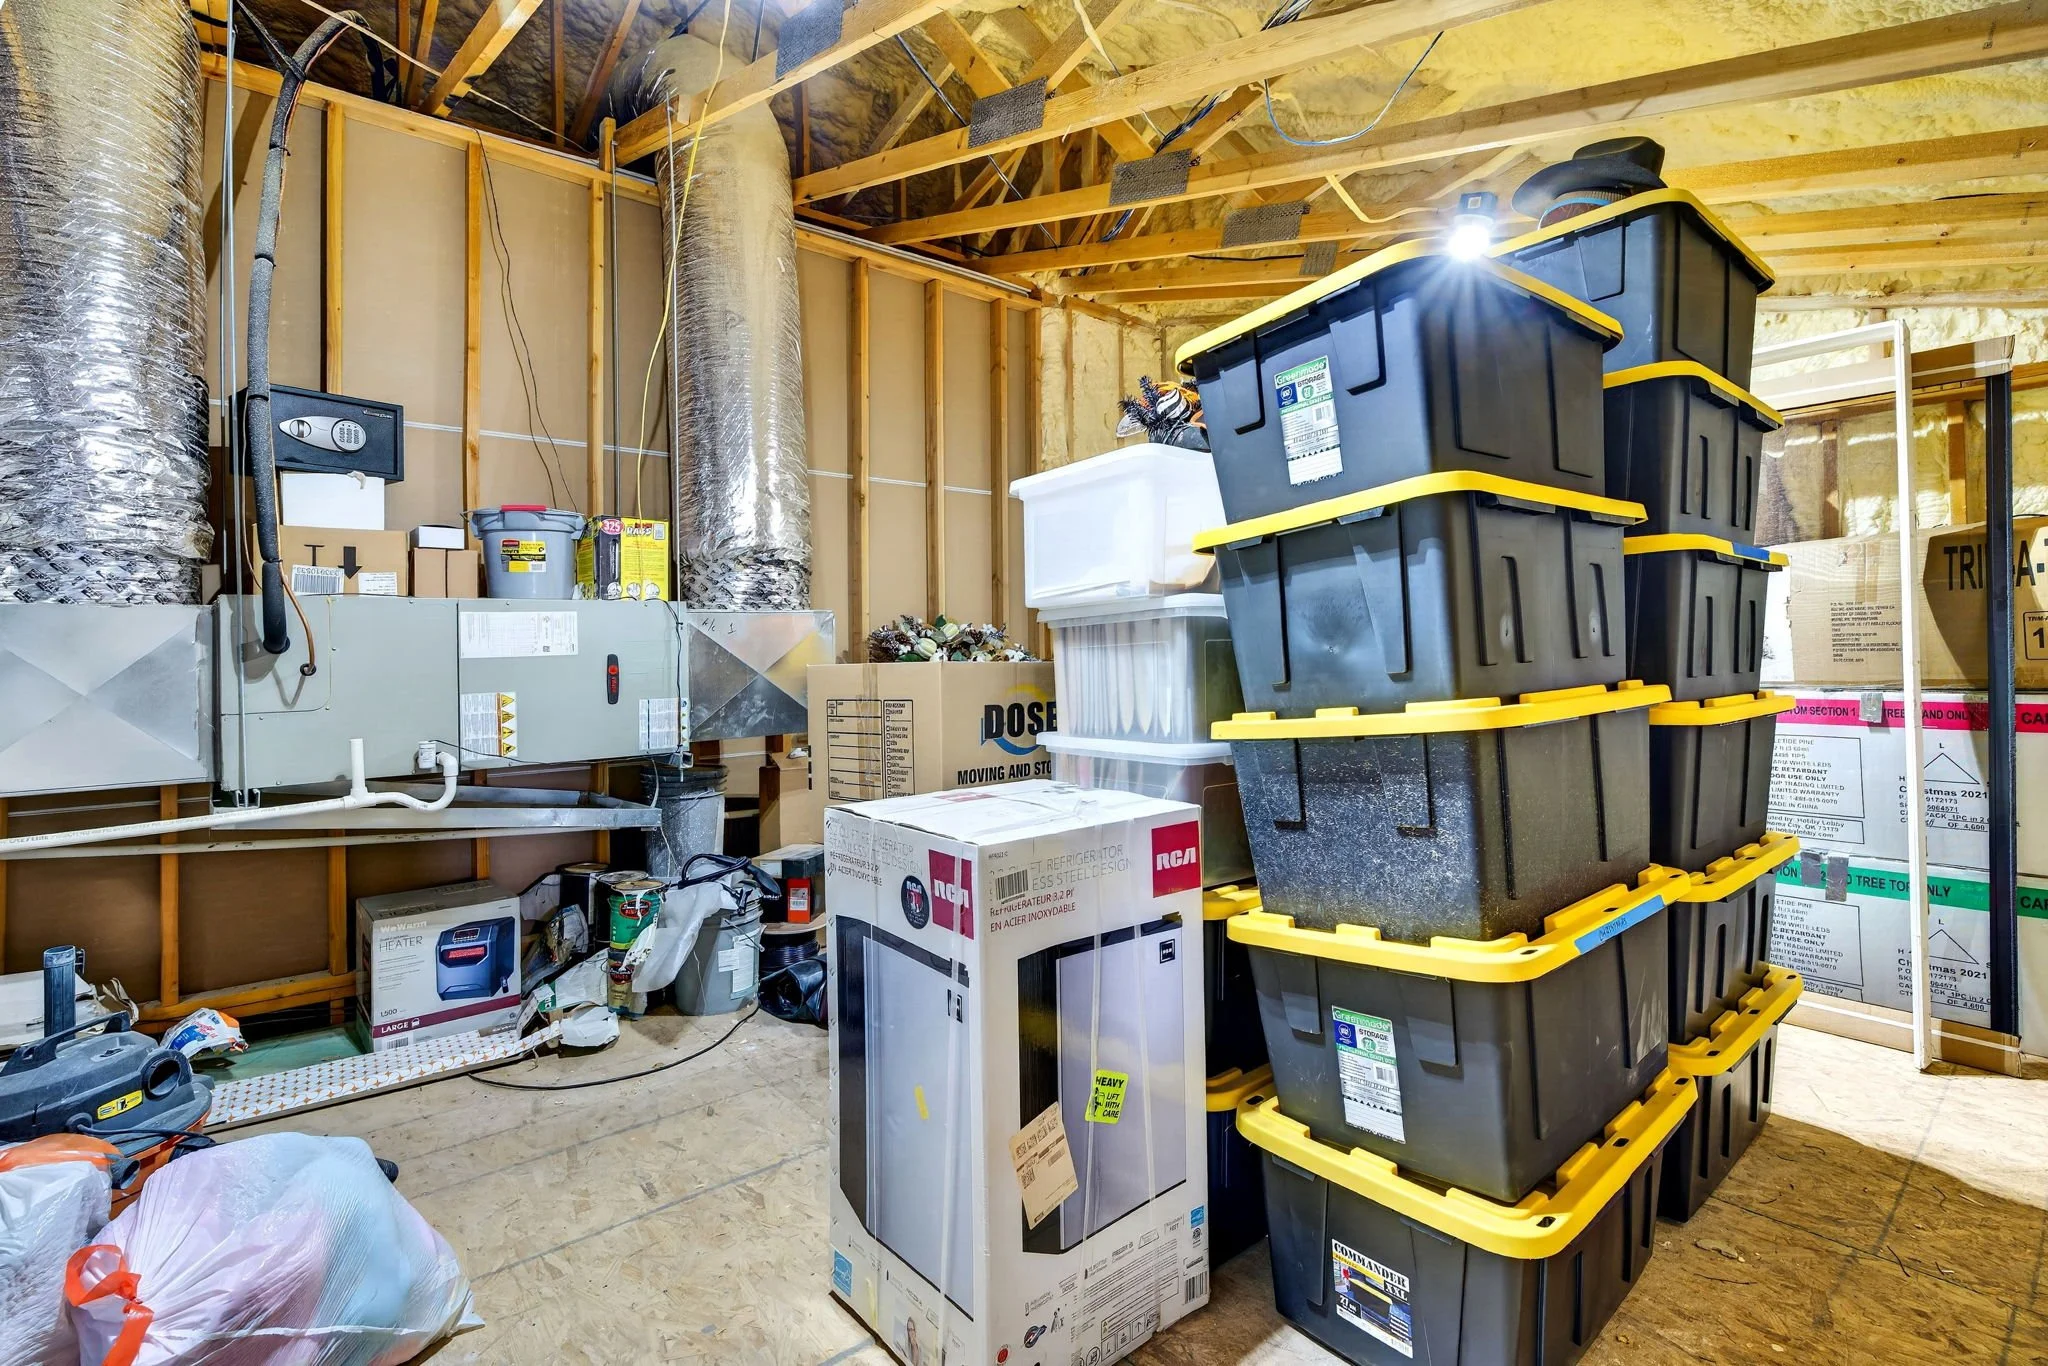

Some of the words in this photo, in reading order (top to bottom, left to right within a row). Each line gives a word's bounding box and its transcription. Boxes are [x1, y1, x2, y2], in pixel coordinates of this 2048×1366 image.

[1276, 361, 1325, 384] Greenmade
[603, 521, 620, 533] 325
[1810, 707, 1849, 717] SECTION
[1946, 710, 1975, 720] ONLY
[957, 766, 1005, 786] MOVING
[1008, 763, 1031, 779] AND
[1781, 767, 1828, 775] RETARDANT
[1800, 789, 1840, 797] WARRANTY
[1961, 790, 1988, 799] 2021
[1046, 844, 1123, 872] REFRIGERATOR
[1156, 846, 1197, 871] RCA
[1057, 867, 1090, 888] STEEL
[1092, 858, 1131, 880] DESIGN
[1856, 875, 1886, 889] TREE
[990, 921, 1002, 933] EN
[1004, 914, 1027, 930] ACIER
[1028, 902, 1076, 923] INOXYDABLE
[1780, 927, 1827, 940] RETARDANT
[380, 935, 423, 952] HEATER
[1784, 942, 1814, 952] TRADING
[1816, 948, 1844, 957] LIMITED
[1804, 939, 1826, 947] ONLY
[1798, 952, 1839, 964] WARRANTY
[1796, 965, 1818, 973] CHINA
[1960, 968, 1987, 979] 2021
[1335, 1010, 1390, 1030] Greenmade
[381, 1021, 409, 1034] LARGE
[1358, 1028, 1389, 1041] STORAGE
[1095, 1076, 1124, 1089] HEAVY
[1107, 1093, 1120, 1101] LIFT
[1104, 1101, 1120, 1109] WITH
[1102, 1109, 1119, 1119] CARE
[1334, 1242, 1407, 1288] COMMANDER
[1385, 1282, 1408, 1301] XXL
